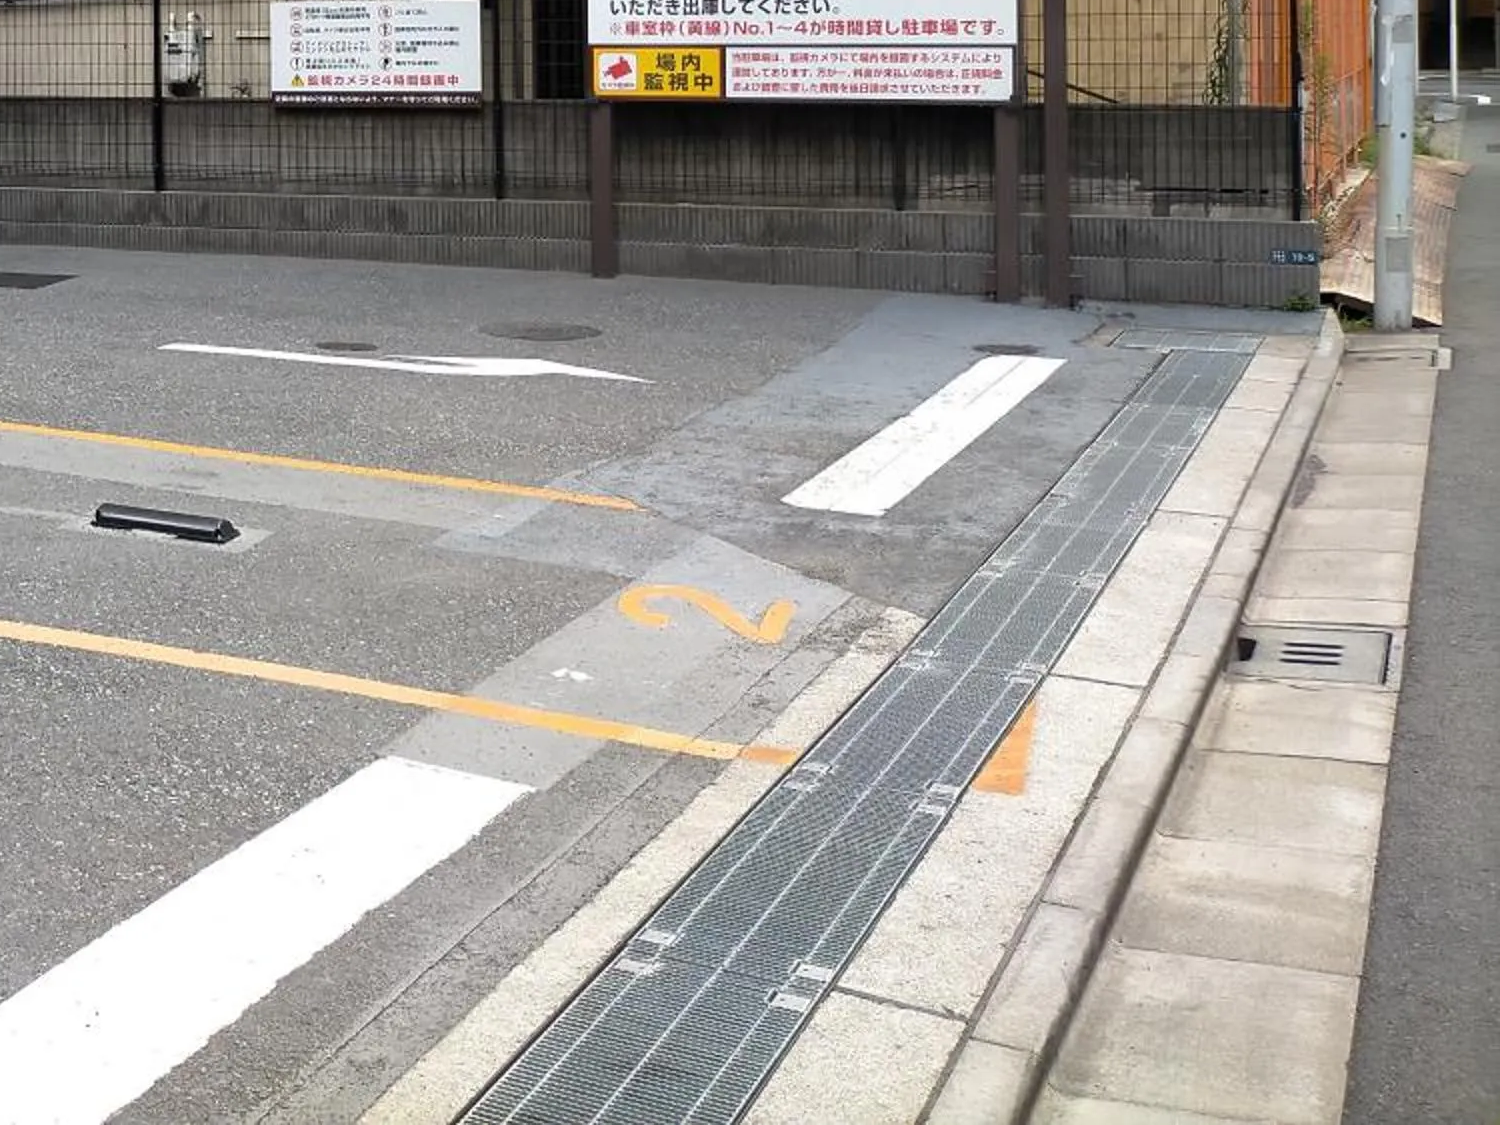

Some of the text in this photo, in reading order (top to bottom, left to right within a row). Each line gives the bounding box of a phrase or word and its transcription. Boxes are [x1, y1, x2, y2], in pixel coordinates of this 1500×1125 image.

[655, 52, 701, 71] 場内
[307, 74, 460, 87] 監視カメラ24時間録画中
[644, 72, 713, 91] 監視中
[617, 582, 798, 645] 2
